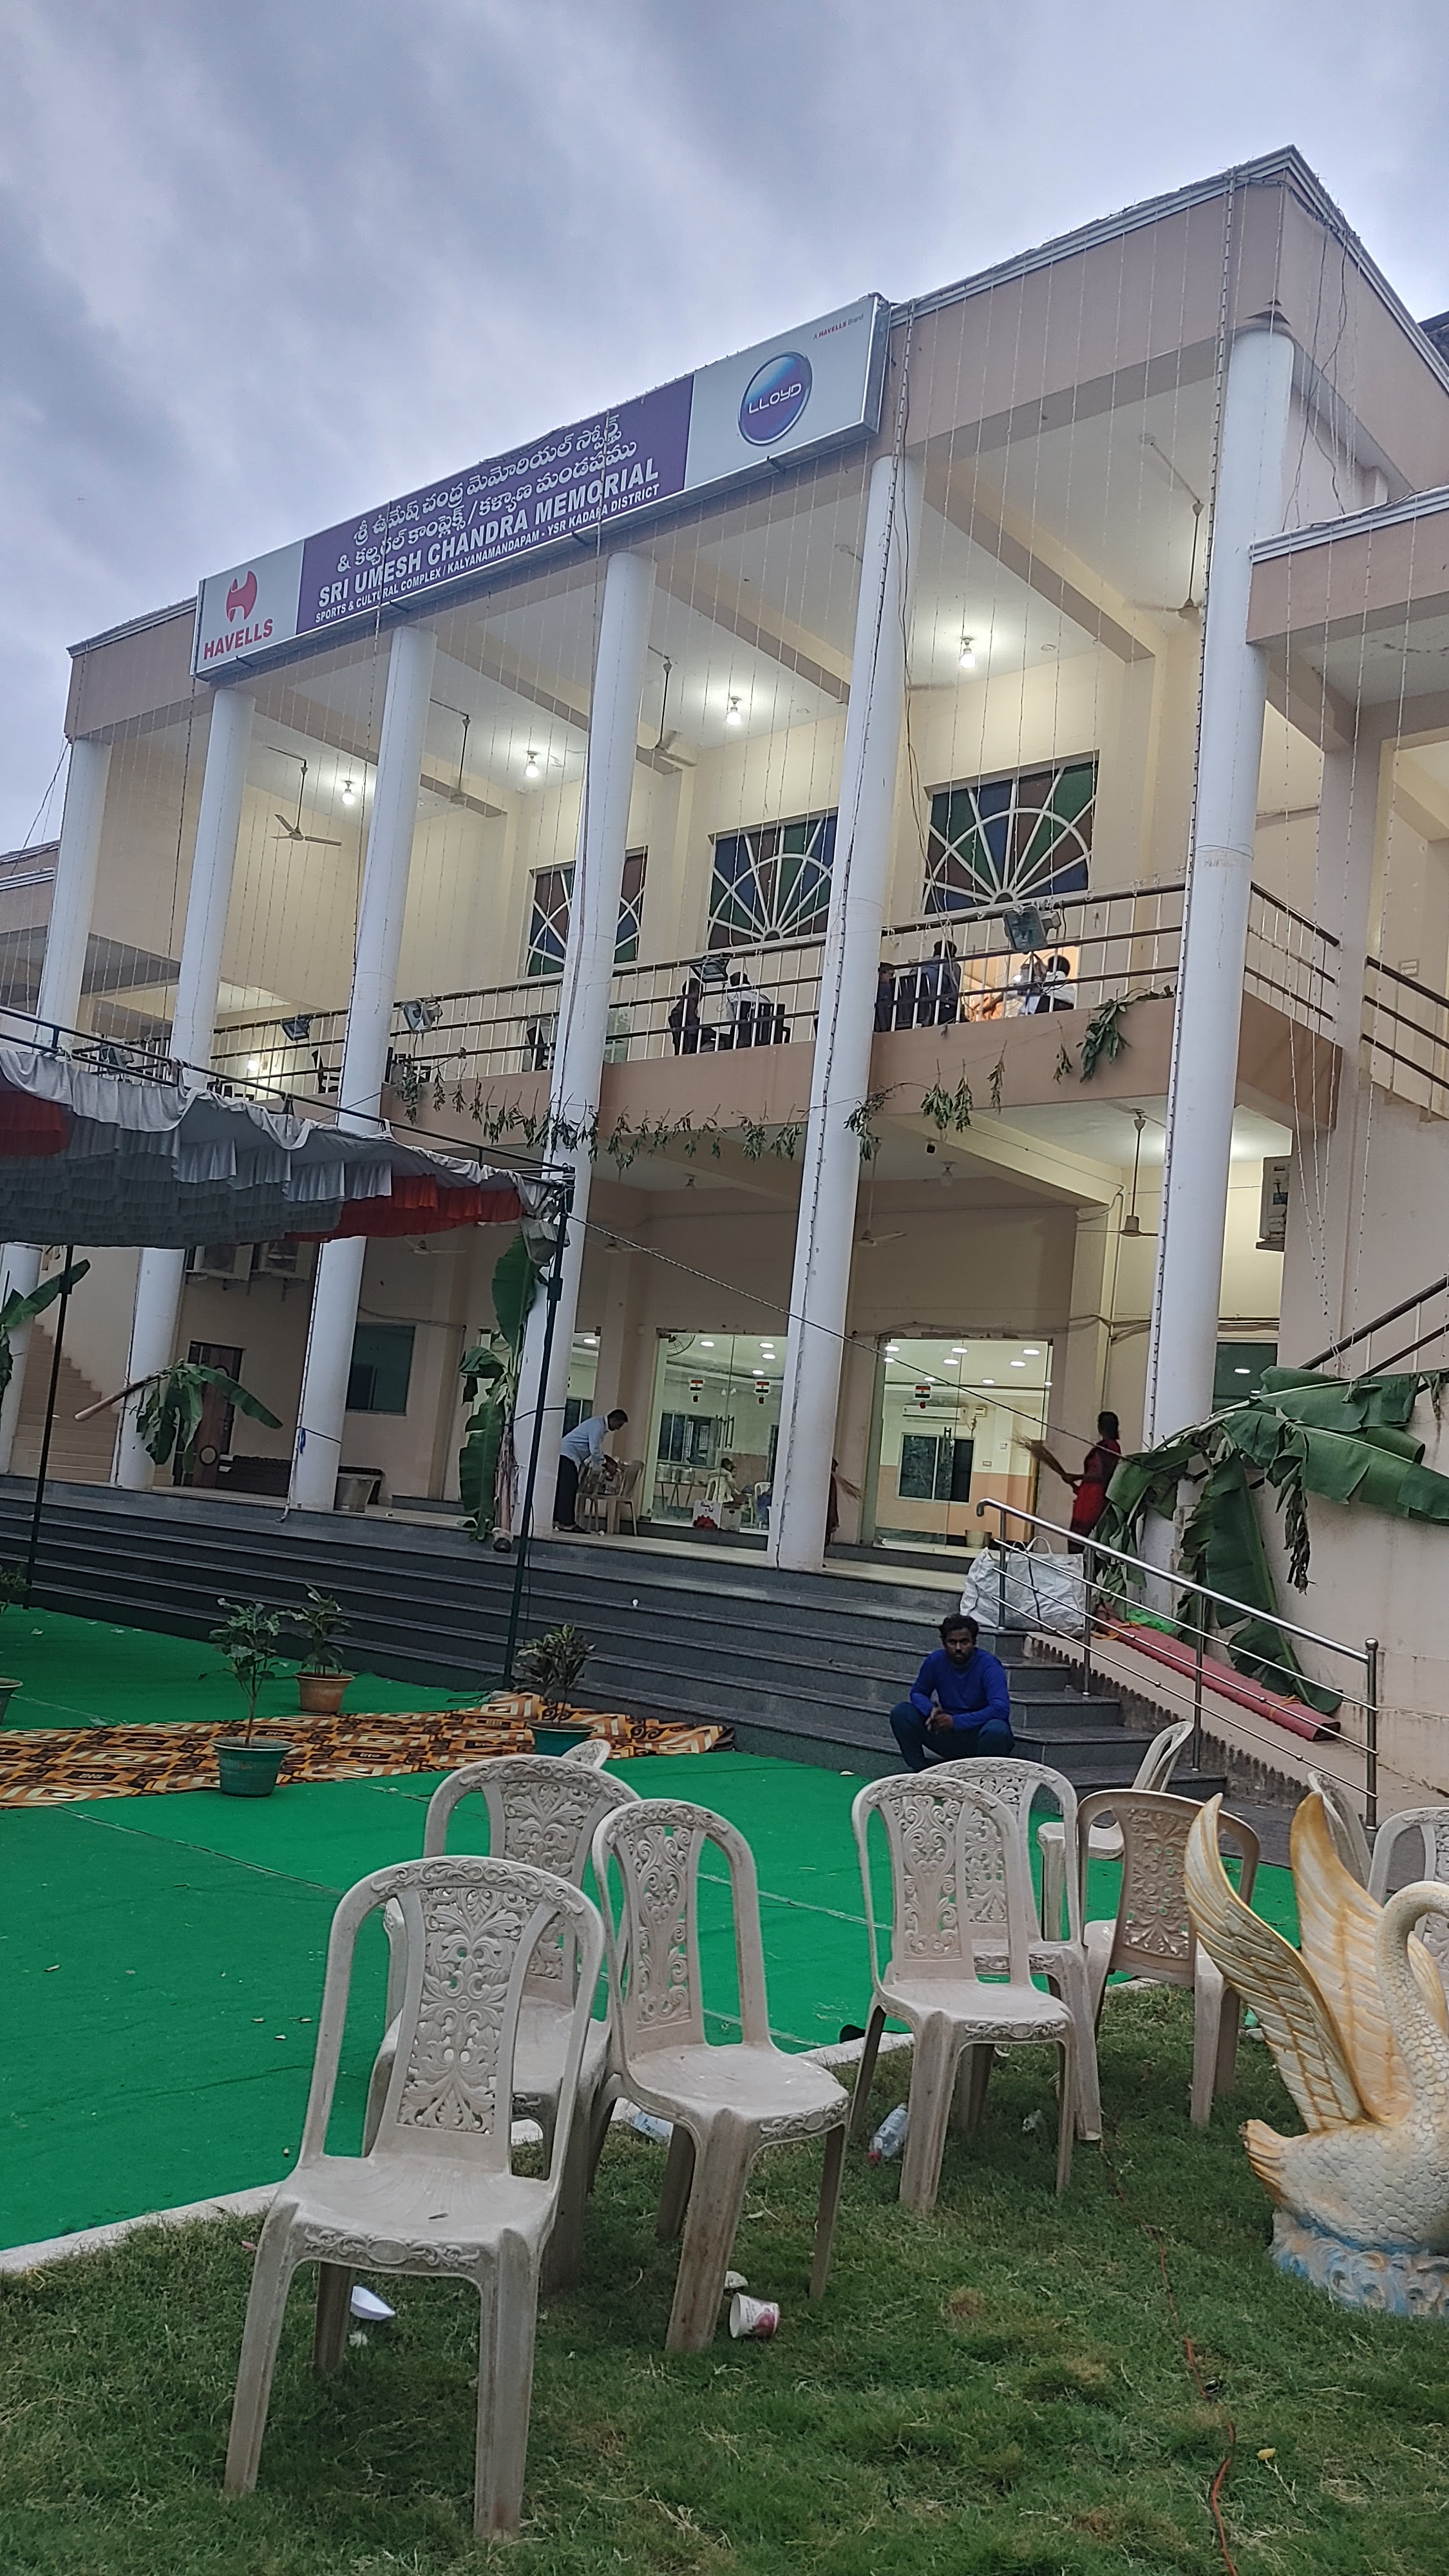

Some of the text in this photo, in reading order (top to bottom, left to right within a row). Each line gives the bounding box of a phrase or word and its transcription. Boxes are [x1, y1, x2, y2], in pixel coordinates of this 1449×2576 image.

[819, 321, 847, 337] HAVELLS
[848, 314, 864, 325] Brand
[748, 383, 802, 414] LLOYD
[353, 519, 368, 545] శ్రీ
[372, 499, 420, 535] ఉమేష్
[421, 482, 463, 513] చంద్ర
[466, 432, 574, 495] మెమోరియల్
[318, 457, 659, 607] SRI UMESH CHANDRA MEMORIAL
[315, 603, 346, 623] SPORTS
[347, 600, 354, 611] &
[355, 583, 399, 608] CULTURAL
[400, 566, 441, 591] COMPLEX
[446, 529, 540, 574] KALYANAMANDAPAM
[547, 519, 566, 536] YSR
[610, 482, 659, 513] DISTRICT
[337, 554, 351, 572] &
[204, 619, 273, 659] HAVELLS
